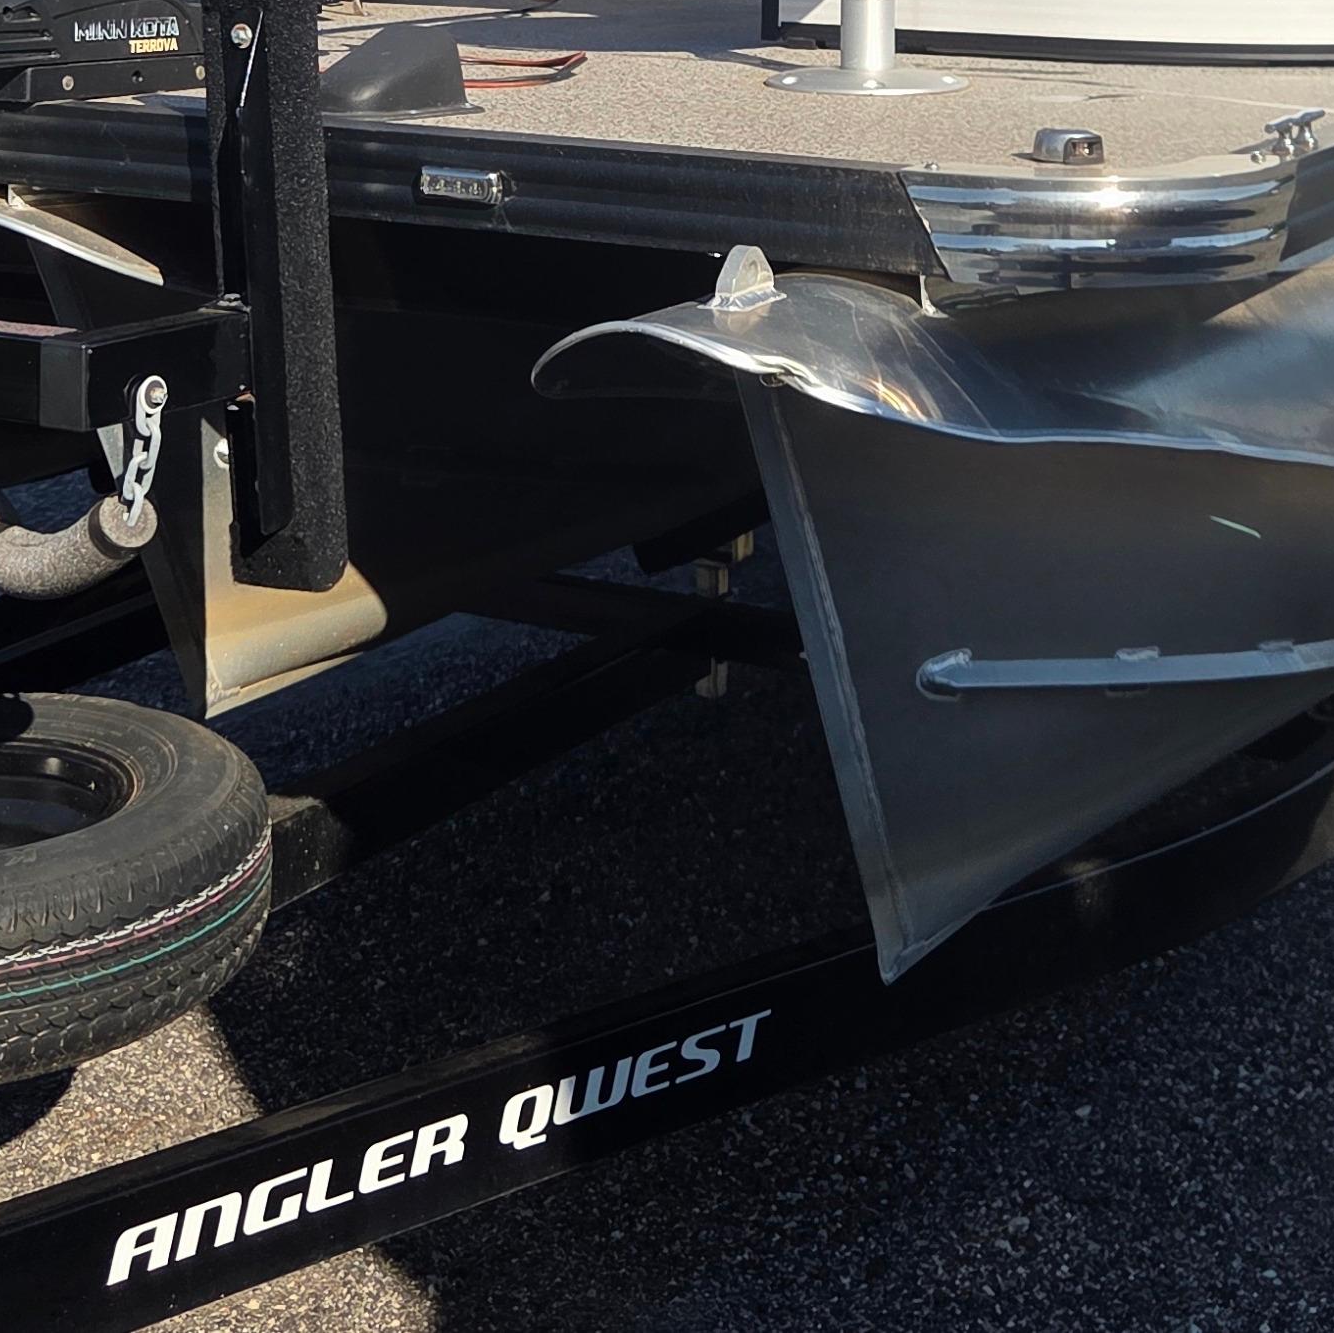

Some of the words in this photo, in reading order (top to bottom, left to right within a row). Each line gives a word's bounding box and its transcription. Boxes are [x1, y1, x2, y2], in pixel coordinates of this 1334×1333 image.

[74, 18, 127, 42] MINN
[130, 16, 180, 39] KOTA
[129, 38, 179, 54] TERROVA
[106, 1113, 468, 1286] ANGLER
[498, 1009, 771, 1150] QWEST
